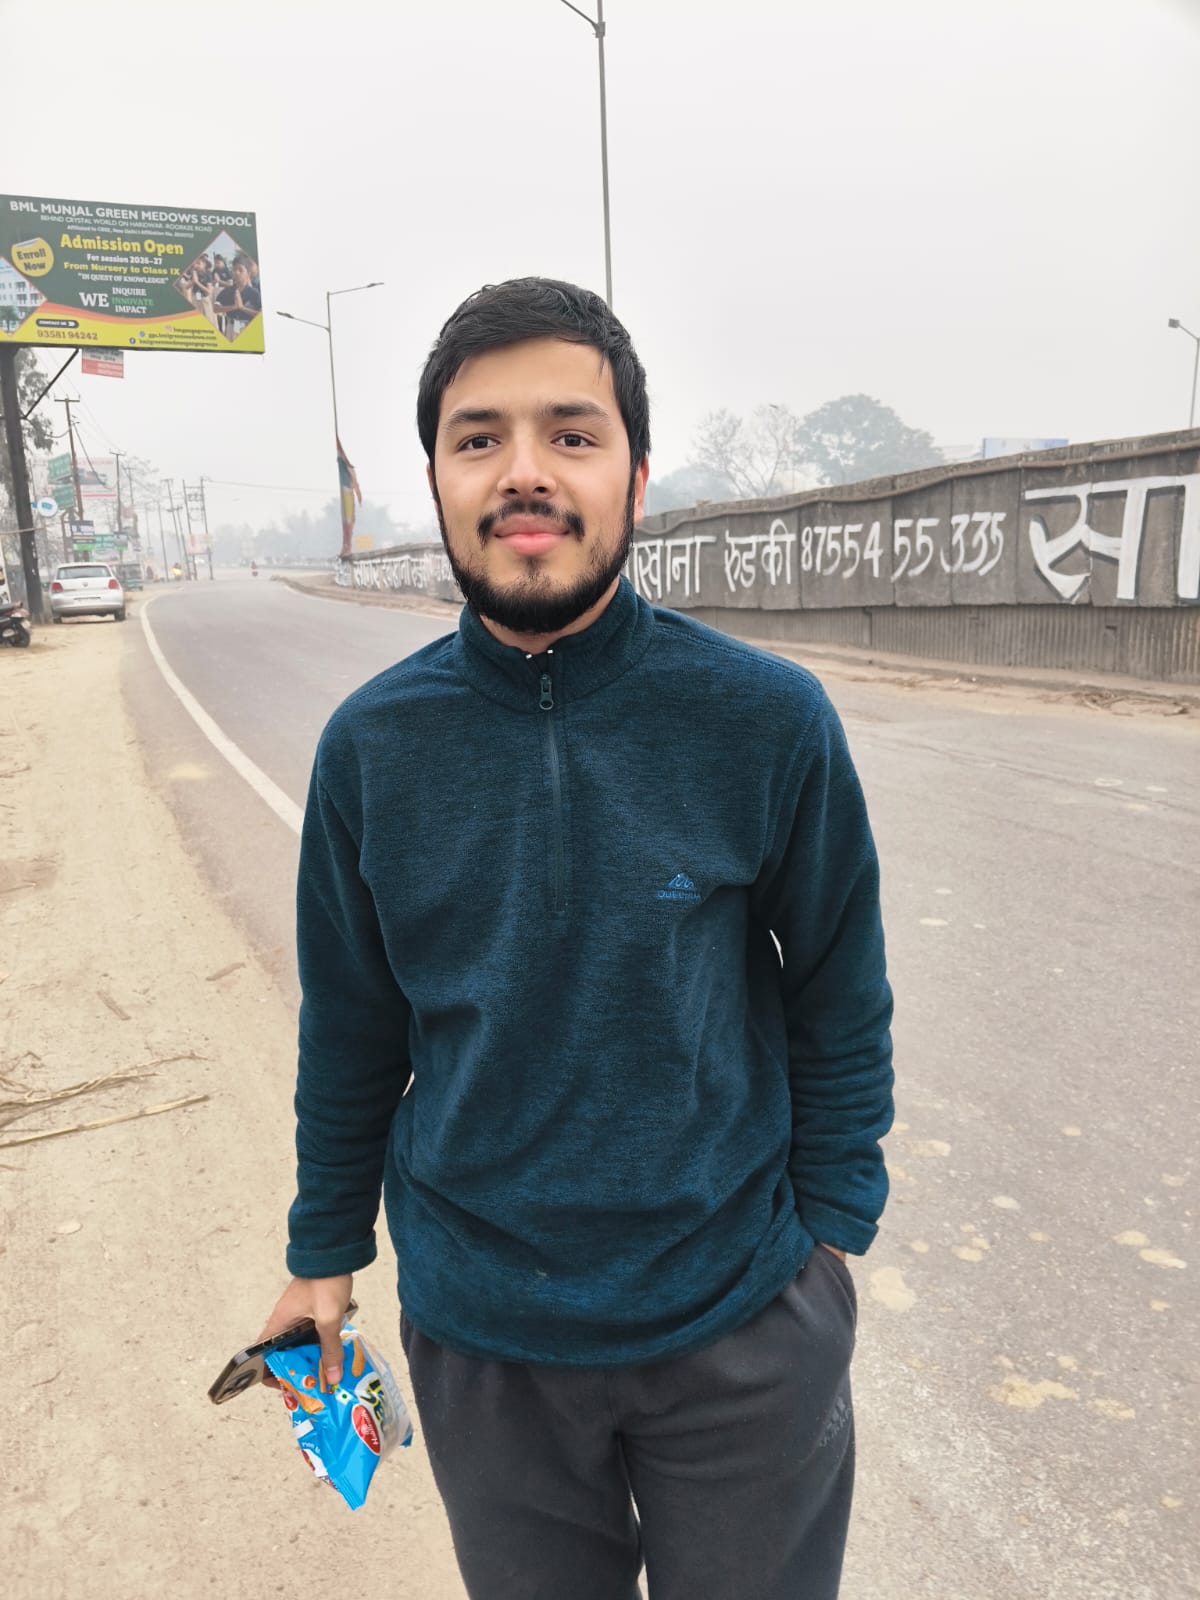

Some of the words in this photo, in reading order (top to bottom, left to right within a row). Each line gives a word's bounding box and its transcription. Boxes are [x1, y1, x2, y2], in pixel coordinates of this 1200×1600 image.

[9, 201, 38, 212] BML
[40, 203, 93, 216] MUNJAL
[95, 208, 138, 220] GREEN
[141, 210, 198, 224] MEDOWS
[200, 214, 252, 228] SCHOOL
[40, 215, 64, 223] BEHIND
[65, 216, 92, 225] CRYSTAL
[118, 220, 129, 228] ON
[195, 225, 213, 233] ROAD
[60, 233, 141, 253] Admission
[143, 239, 184, 256] Open
[16, 248, 47, 260] Enroll
[86, 253, 99, 262] For
[101, 255, 129, 263] session
[23, 261, 46, 271] Now
[63, 262, 89, 270] From
[91, 263, 127, 274] Nursery
[130, 265, 140, 273] to
[143, 266, 168, 275] Class
[91, 273, 113, 282] QUEST
[112, 287, 146, 296] INQUIRE
[78, 292, 109, 308] WE
[112, 297, 154, 306] INNOVATE
[115, 305, 147, 314] IMPACT
[800, 520, 884, 579] 87554
[890, 517, 940, 583] 55
[940, 511, 1007, 577] 335
